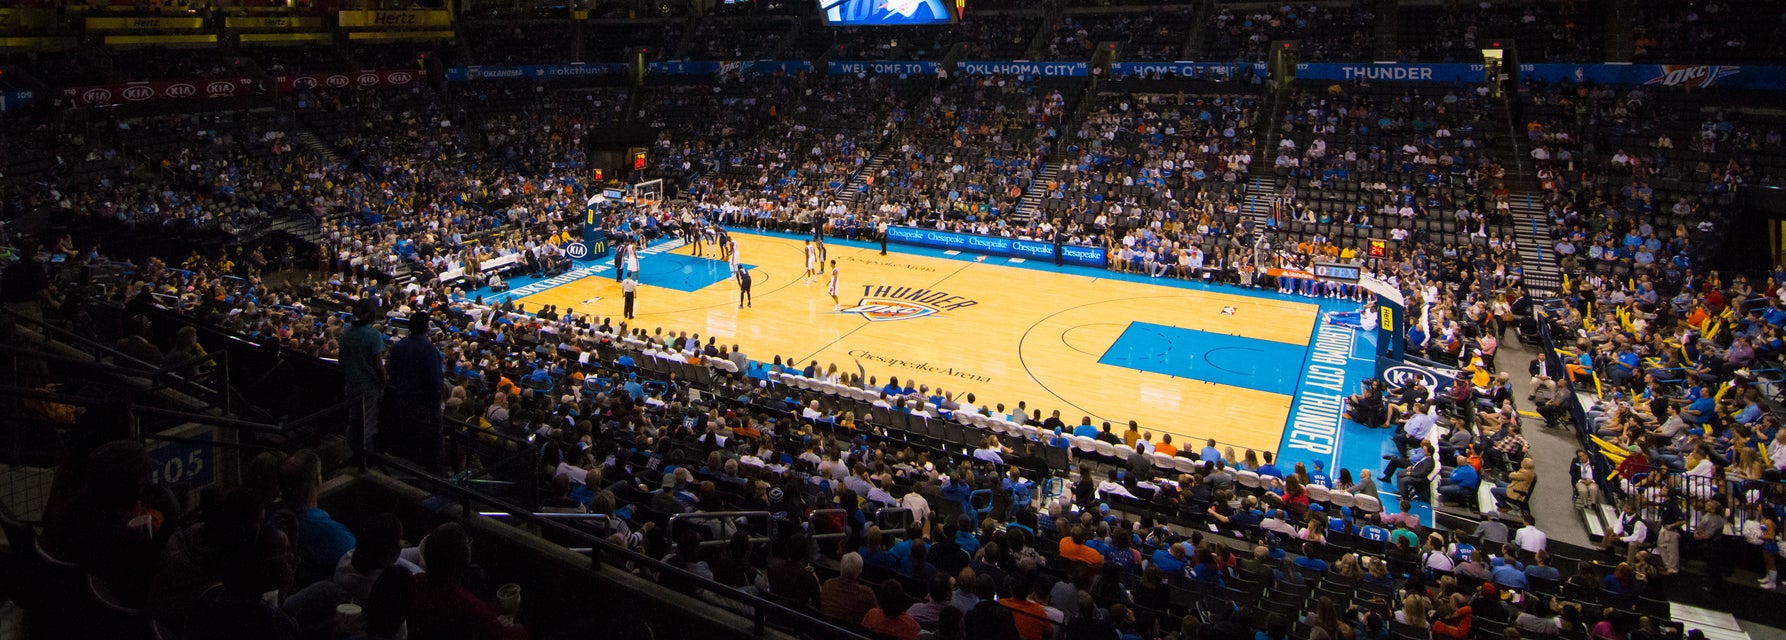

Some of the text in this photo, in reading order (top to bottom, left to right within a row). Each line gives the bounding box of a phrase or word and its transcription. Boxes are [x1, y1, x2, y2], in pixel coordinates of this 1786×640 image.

[133, 19, 161, 27] Hertz
[263, 18, 287, 26] Hertz
[375, 12, 416, 25] Hertz
[483, 69, 523, 78] OKLAHOMA
[841, 63, 922, 74] WELOME TO
[966, 64, 1076, 76] OKLAHOMA CITY
[1342, 66, 1433, 80] THUNDER
[1520, 64, 1535, 72] 118
[1663, 65, 1707, 86] OKC
[63, 88, 77, 96] 110
[127, 87, 150, 99] KIA
[170, 85, 192, 96] KIA
[210, 83, 231, 93] KIA
[16, 91, 33, 99] 109
[86, 92, 107, 103] KIA
[888, 227, 924, 241] Chesapeake
[927, 231, 965, 245] Chesapeake
[969, 236, 1008, 250] Chesapeake
[1012, 241, 1053, 255] Chesapeake
[569, 245, 584, 256] KIA
[1371, 246, 1383, 255] 24
[1317, 266, 1356, 279] O-TEX
[862, 284, 979, 311] THUNDER
[1383, 308, 1391, 328] Hertz
[847, 349, 992, 383] Chesapeake Arena
[1305, 365, 1346, 392] CITY
[1288, 391, 1342, 455] THUNDER
